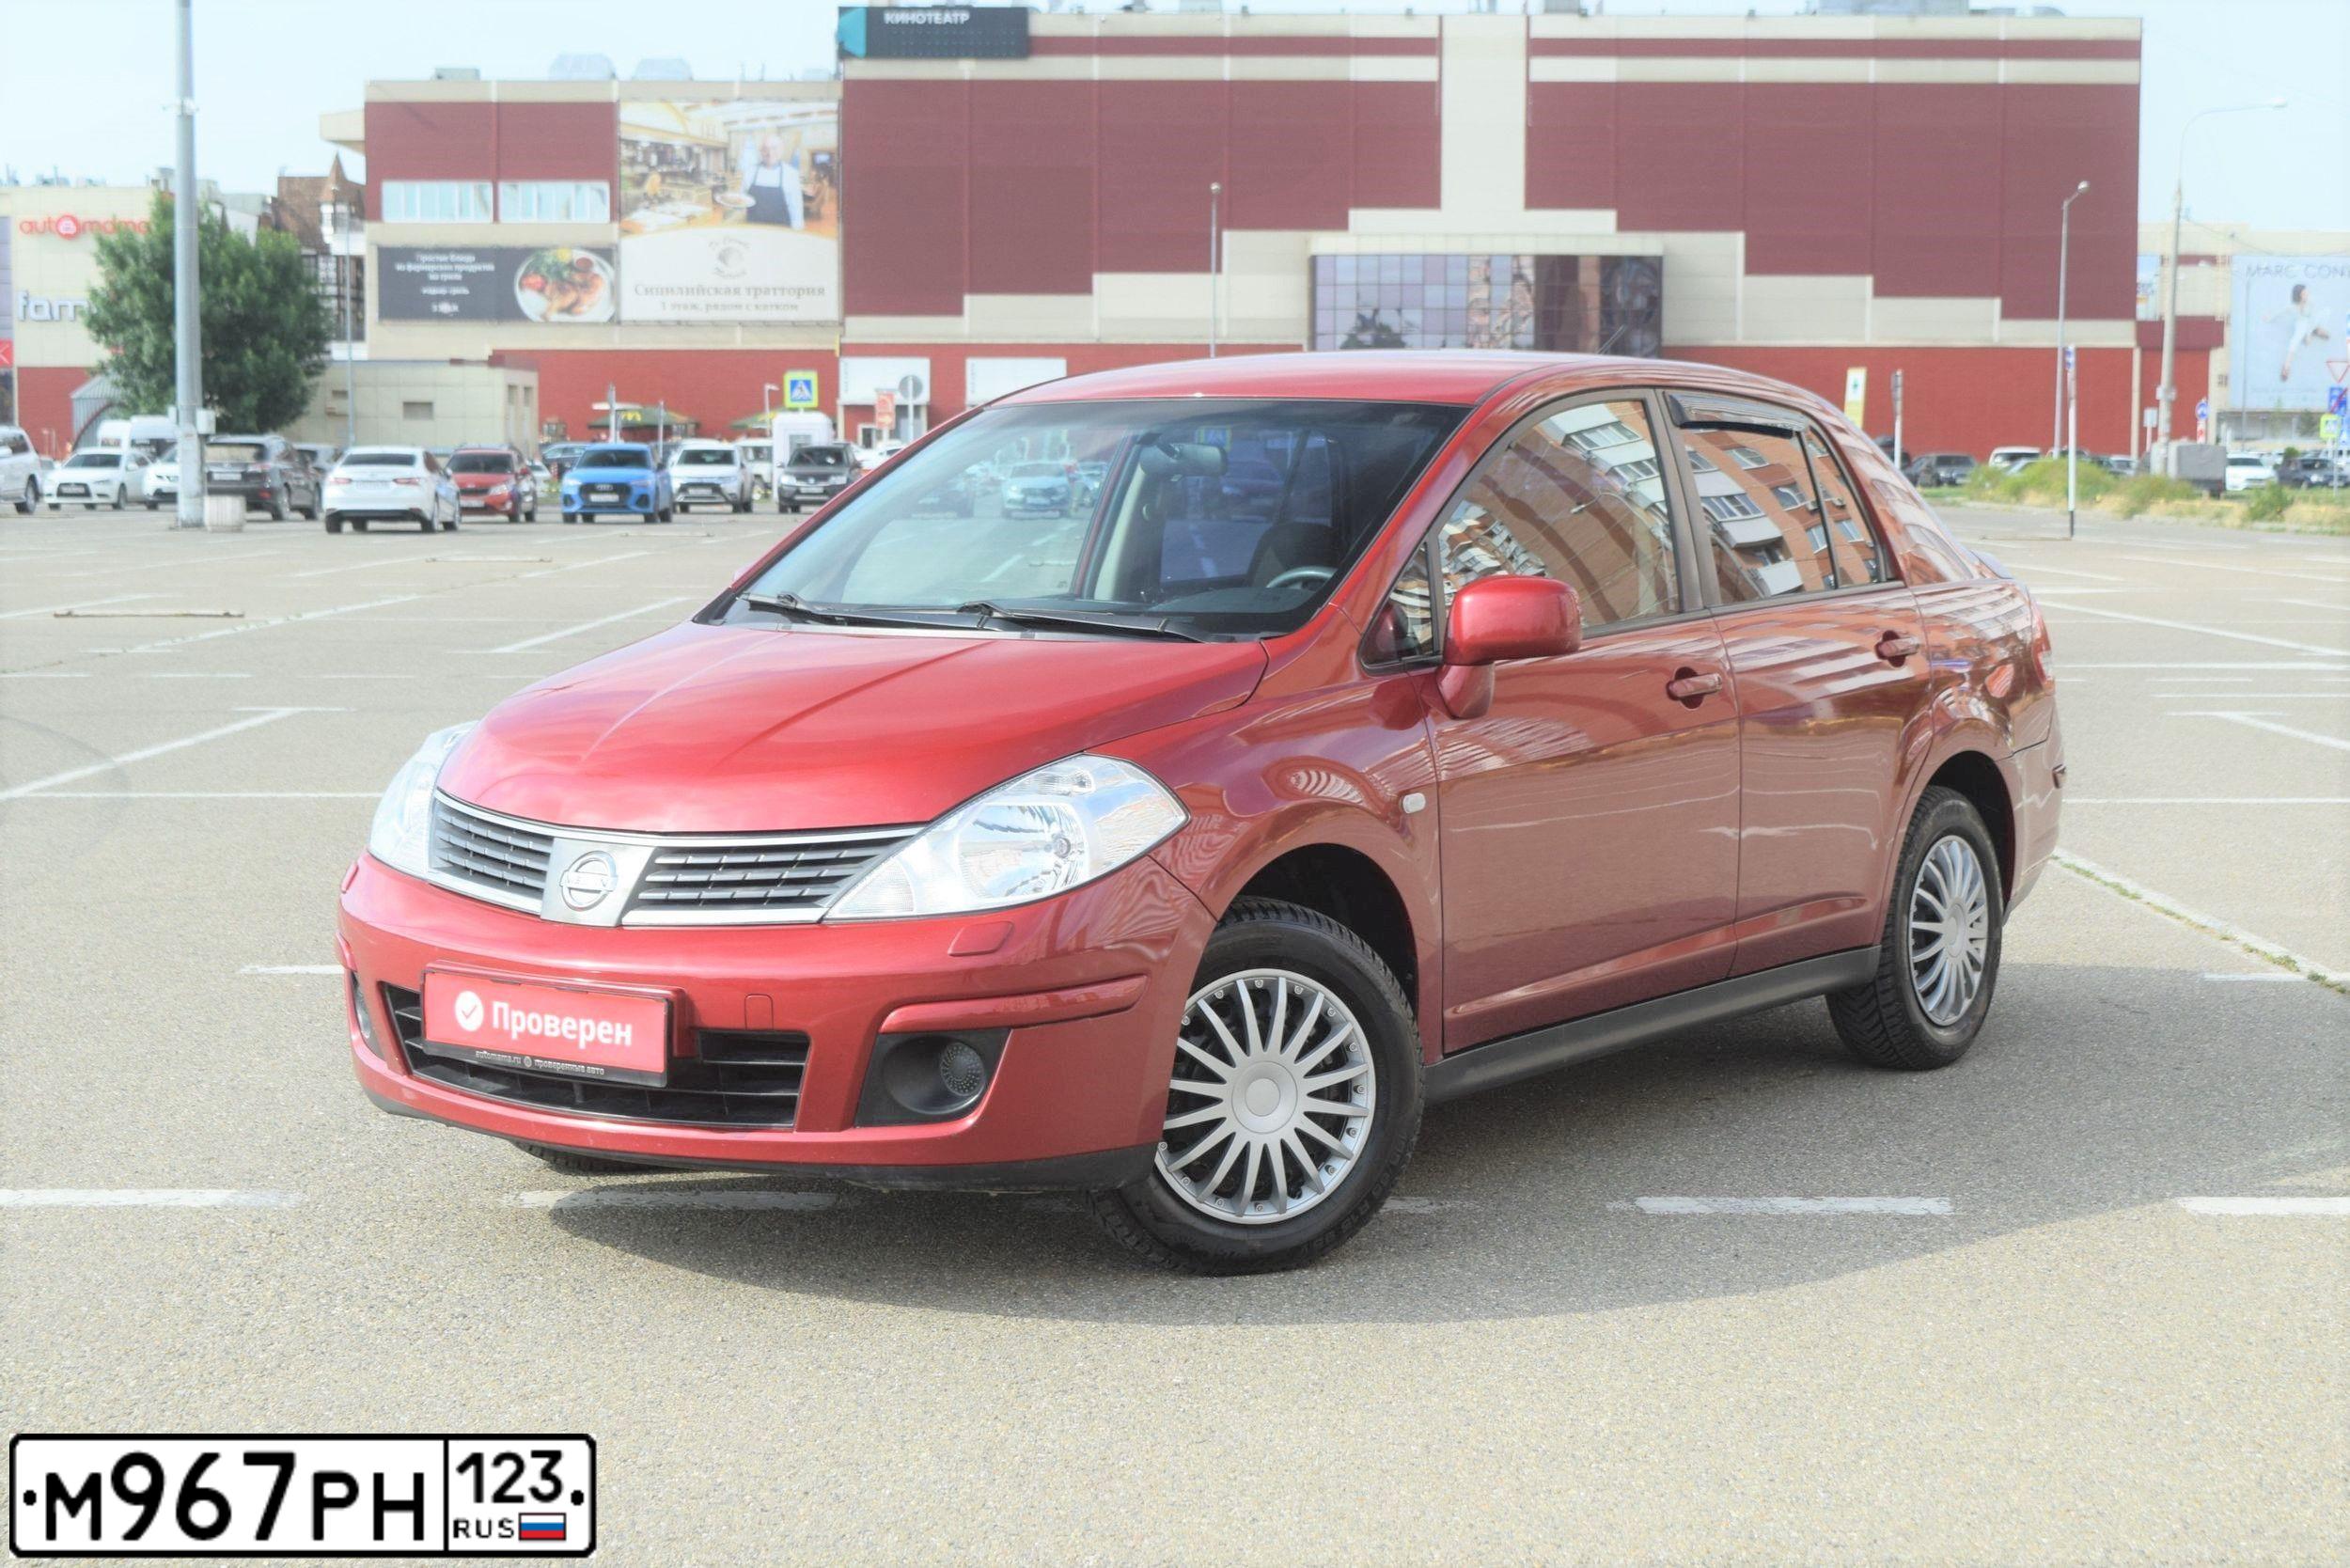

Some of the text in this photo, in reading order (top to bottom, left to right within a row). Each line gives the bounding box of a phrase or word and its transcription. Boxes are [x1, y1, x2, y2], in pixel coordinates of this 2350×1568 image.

[884, 11, 970, 24] КИНОТЕАТР
[2304, 264, 2350, 278] CON
[634, 284, 826, 300] Сицилийская траттория
[493, 1000, 633, 1049] Проверен
[476, 1050, 522, 1064] automama.ru
[534, 1058, 604, 1075] проверенные авто
